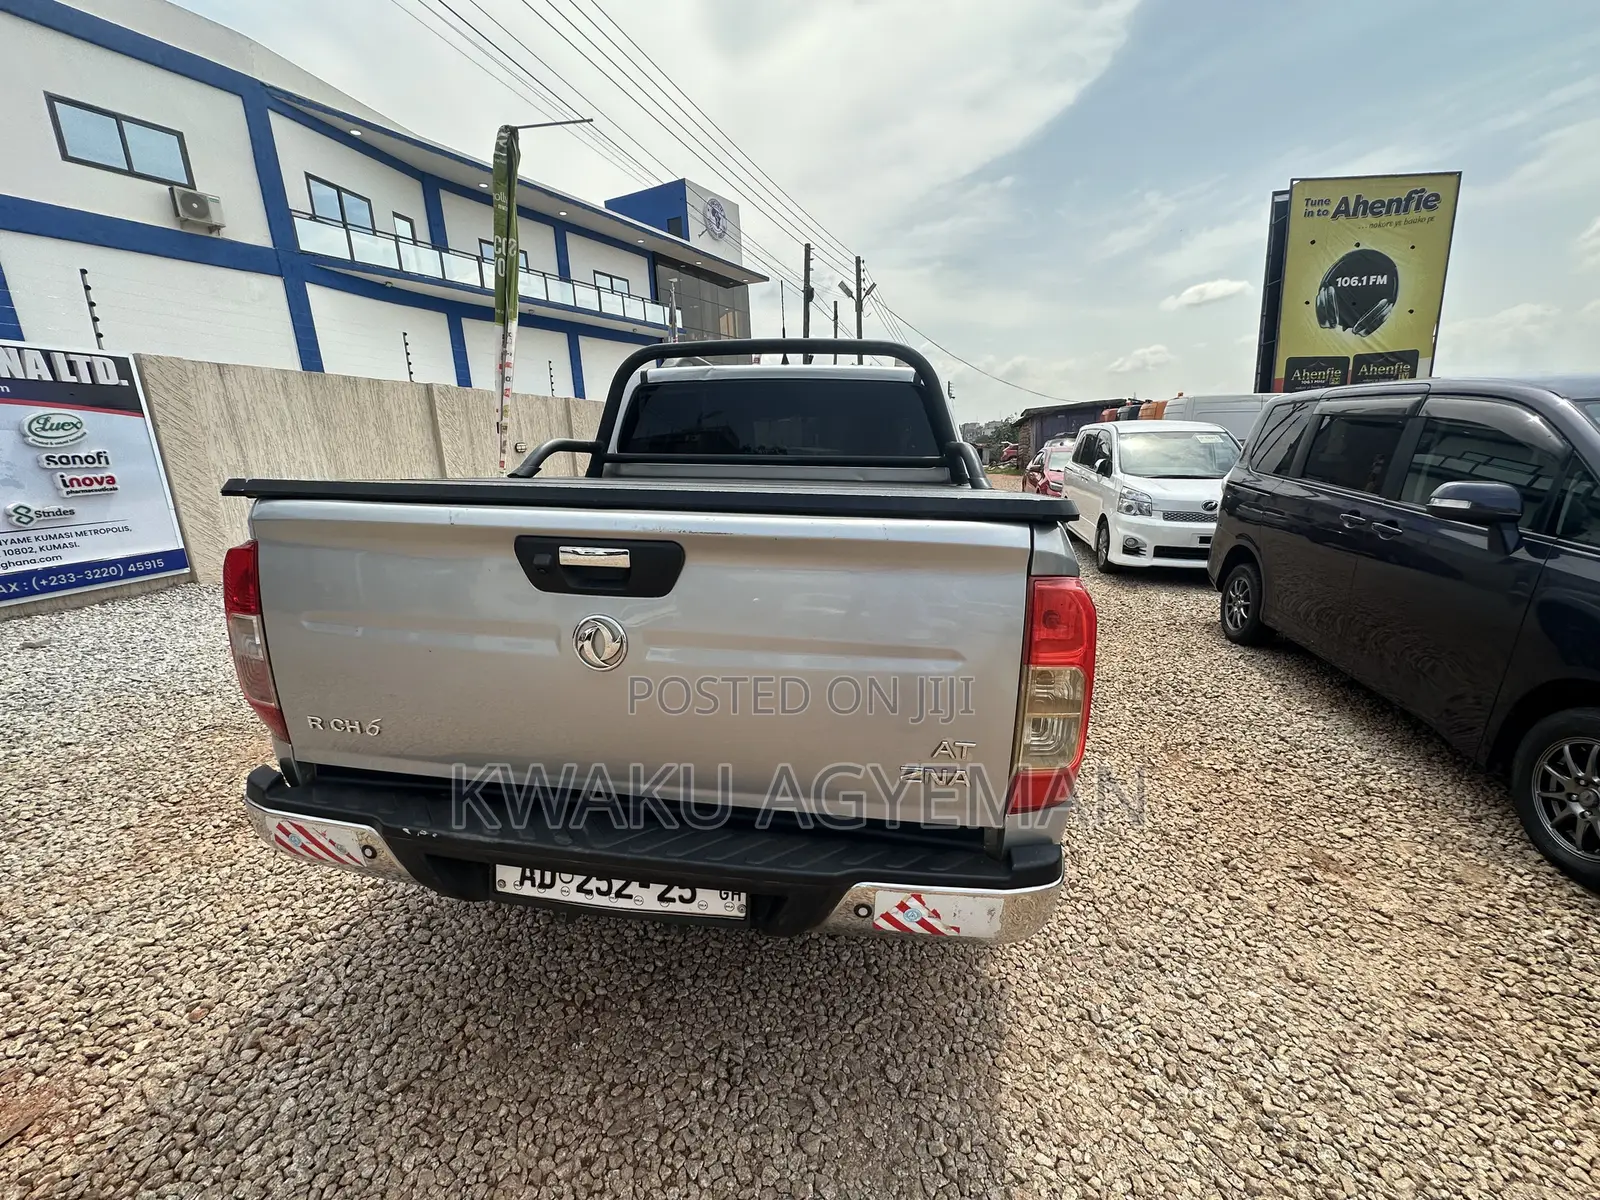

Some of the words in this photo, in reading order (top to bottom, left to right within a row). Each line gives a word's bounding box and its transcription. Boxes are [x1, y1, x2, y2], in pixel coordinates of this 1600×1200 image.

[1304, 197, 1331, 207] Tune
[1331, 187, 1442, 220] Ahenfie
[1303, 209, 1314, 217] in
[1317, 208, 1329, 217] to
[1336, 276, 1367, 287] 106.1
[1369, 275, 1388, 285] FM
[51, 352, 129, 386] LTD.
[1291, 367, 1342, 381] Ahenfie
[1357, 362, 1411, 376] Ahenfie
[35, 416, 82, 432] Luex
[45, 451, 110, 466] sanofi
[60, 474, 116, 488] inova
[34, 508, 75, 519] Strides
[34, 531, 73, 542] KUMASI
[75, 525, 132, 538] METROPOLIS,
[3, 546, 37, 556] 10802,
[39, 541, 80, 553] KUMASI.
[128, 558, 165, 572] 45915
[931, 740, 977, 760] AT
